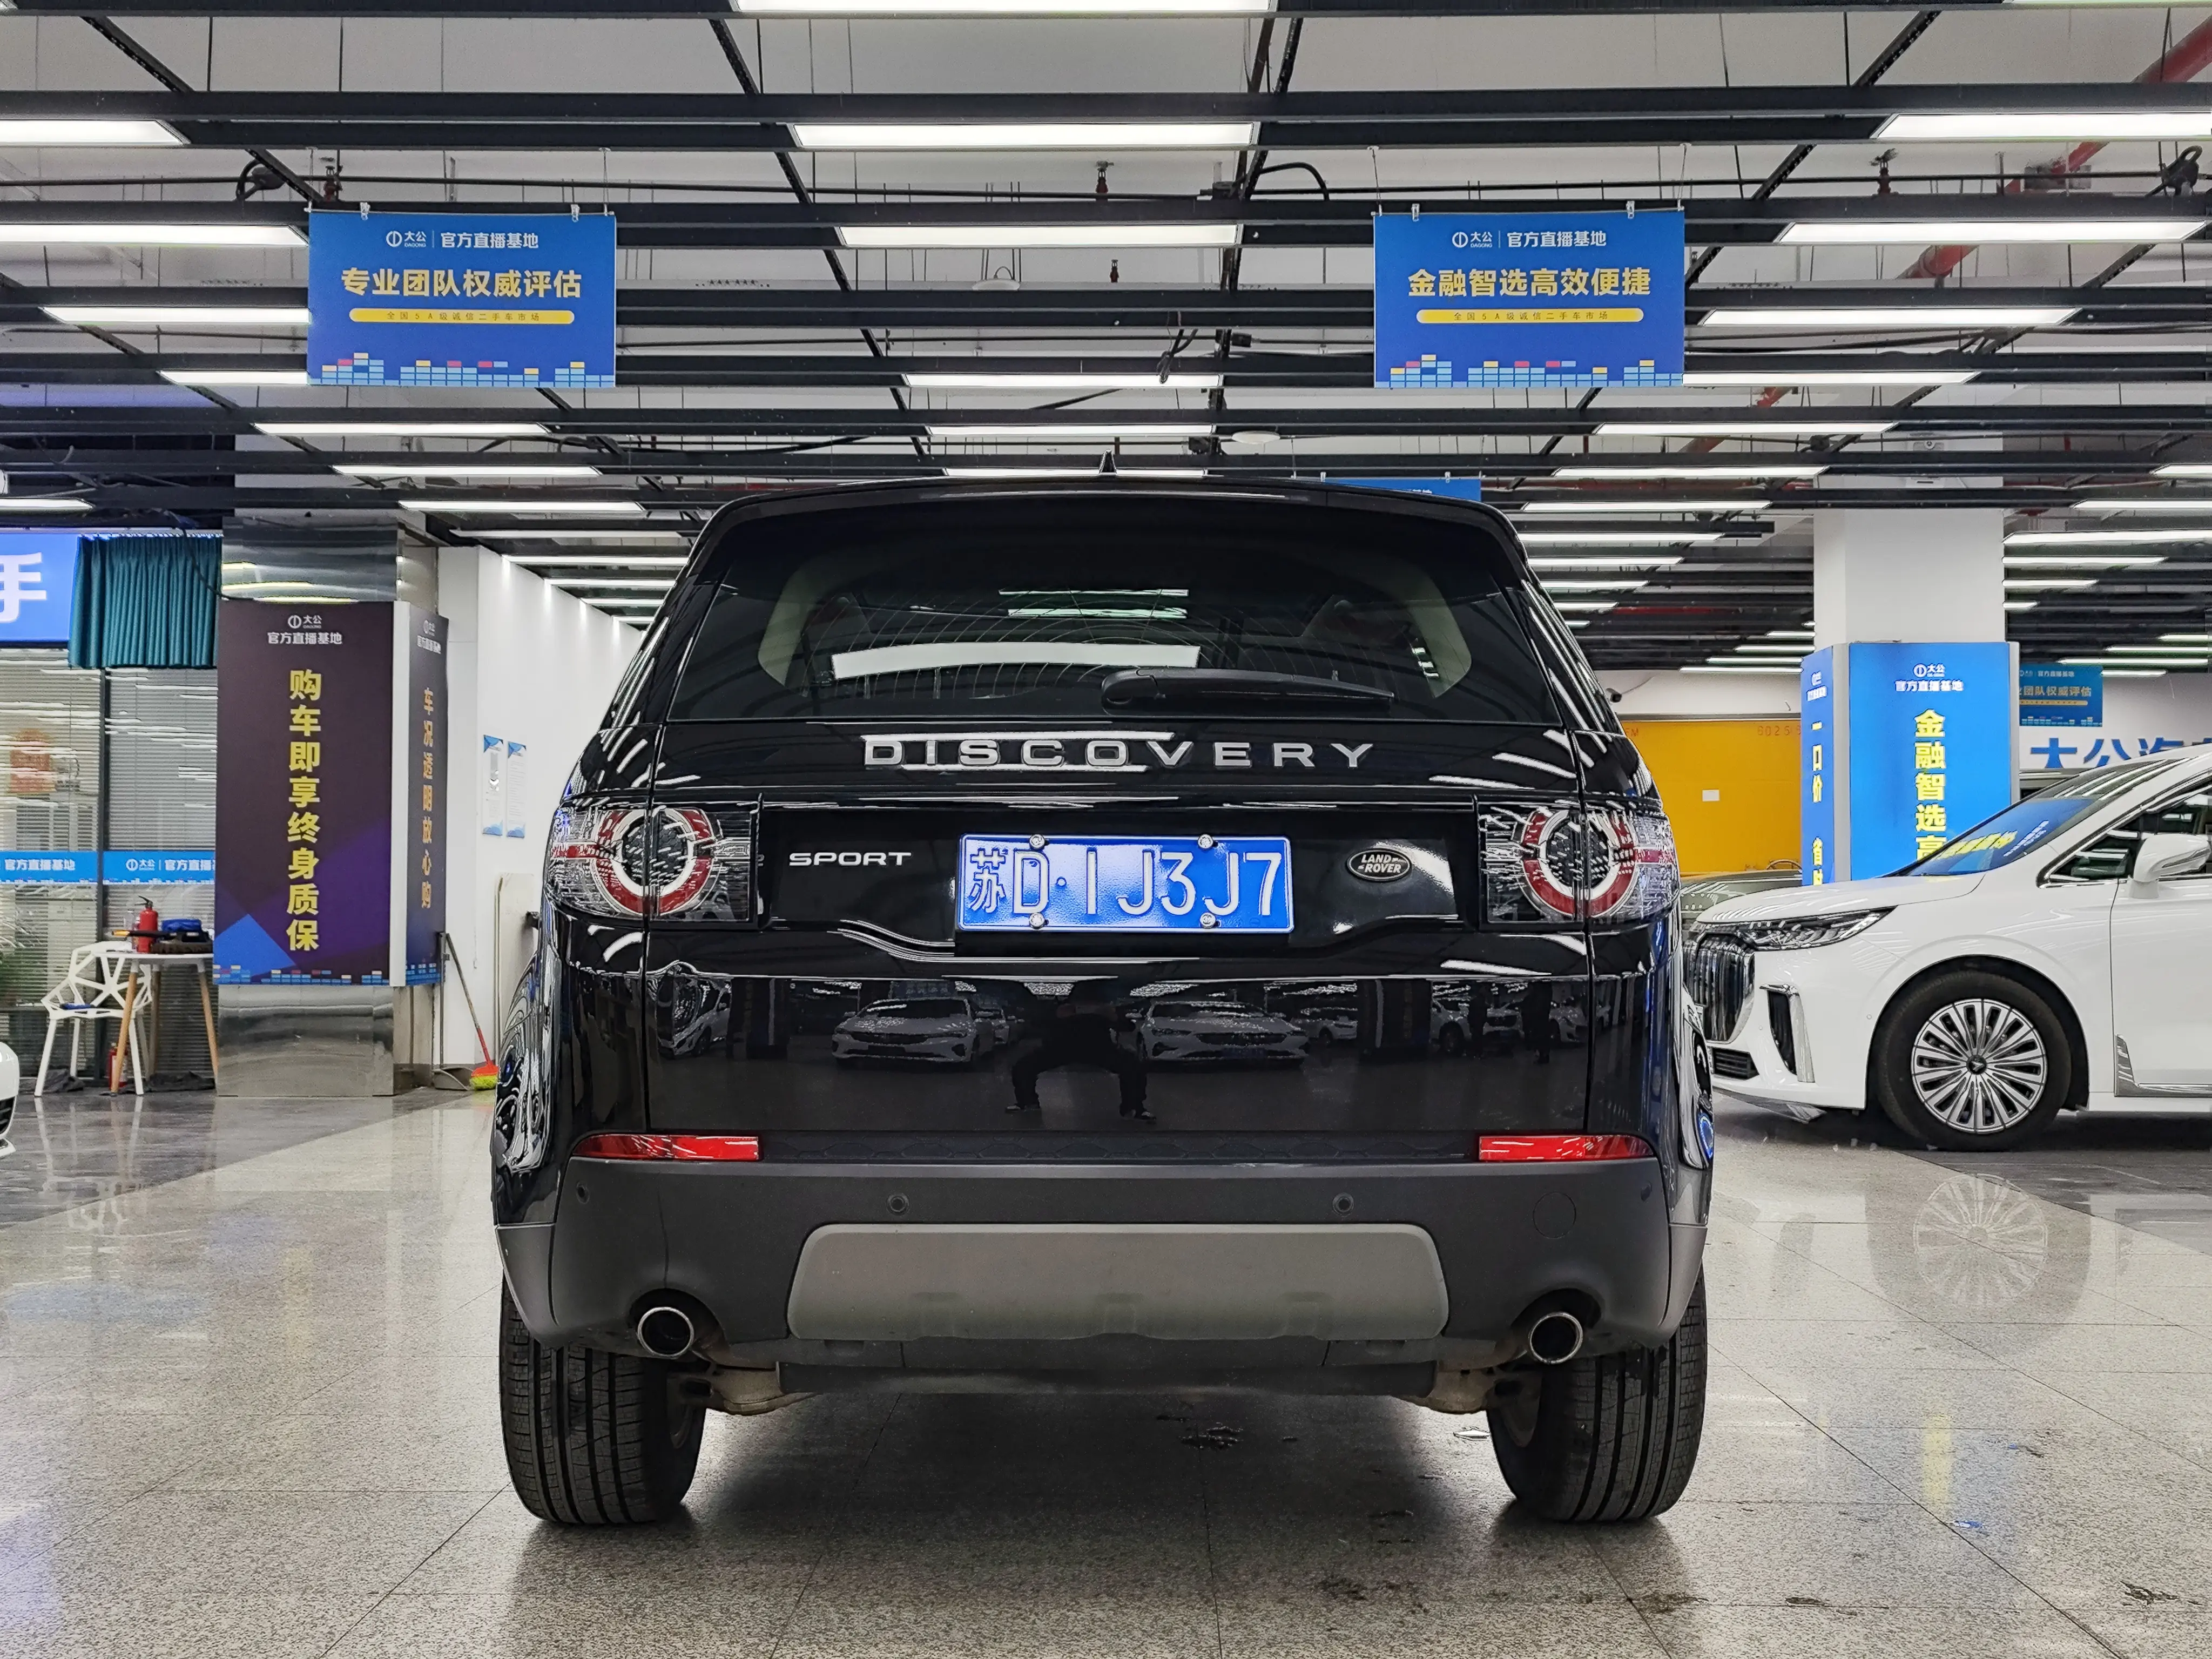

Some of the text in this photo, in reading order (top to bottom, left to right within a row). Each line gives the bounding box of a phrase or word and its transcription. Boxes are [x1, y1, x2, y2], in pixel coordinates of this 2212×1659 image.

[404, 231, 538, 248] 大公 官方直播基地
[1471, 231, 1607, 247] 大公 官方直播基地
[341, 267, 582, 298] 专业团队权威评估
[1408, 267, 1651, 297] 金融智选高效便捷
[303, 615, 322, 624] 大公
[267, 631, 342, 645] 官方直播基地
[865, 740, 1373, 768] DISCOVERY
[286, 669, 322, 952] 购车即享终身质保
[4, 859, 76, 871] 官方直播基地
[165, 859, 215, 871] 官方直播
[790, 852, 912, 866] SPORT
[1361, 854, 1391, 863] LAND
[1365, 863, 1401, 873] ROVER
